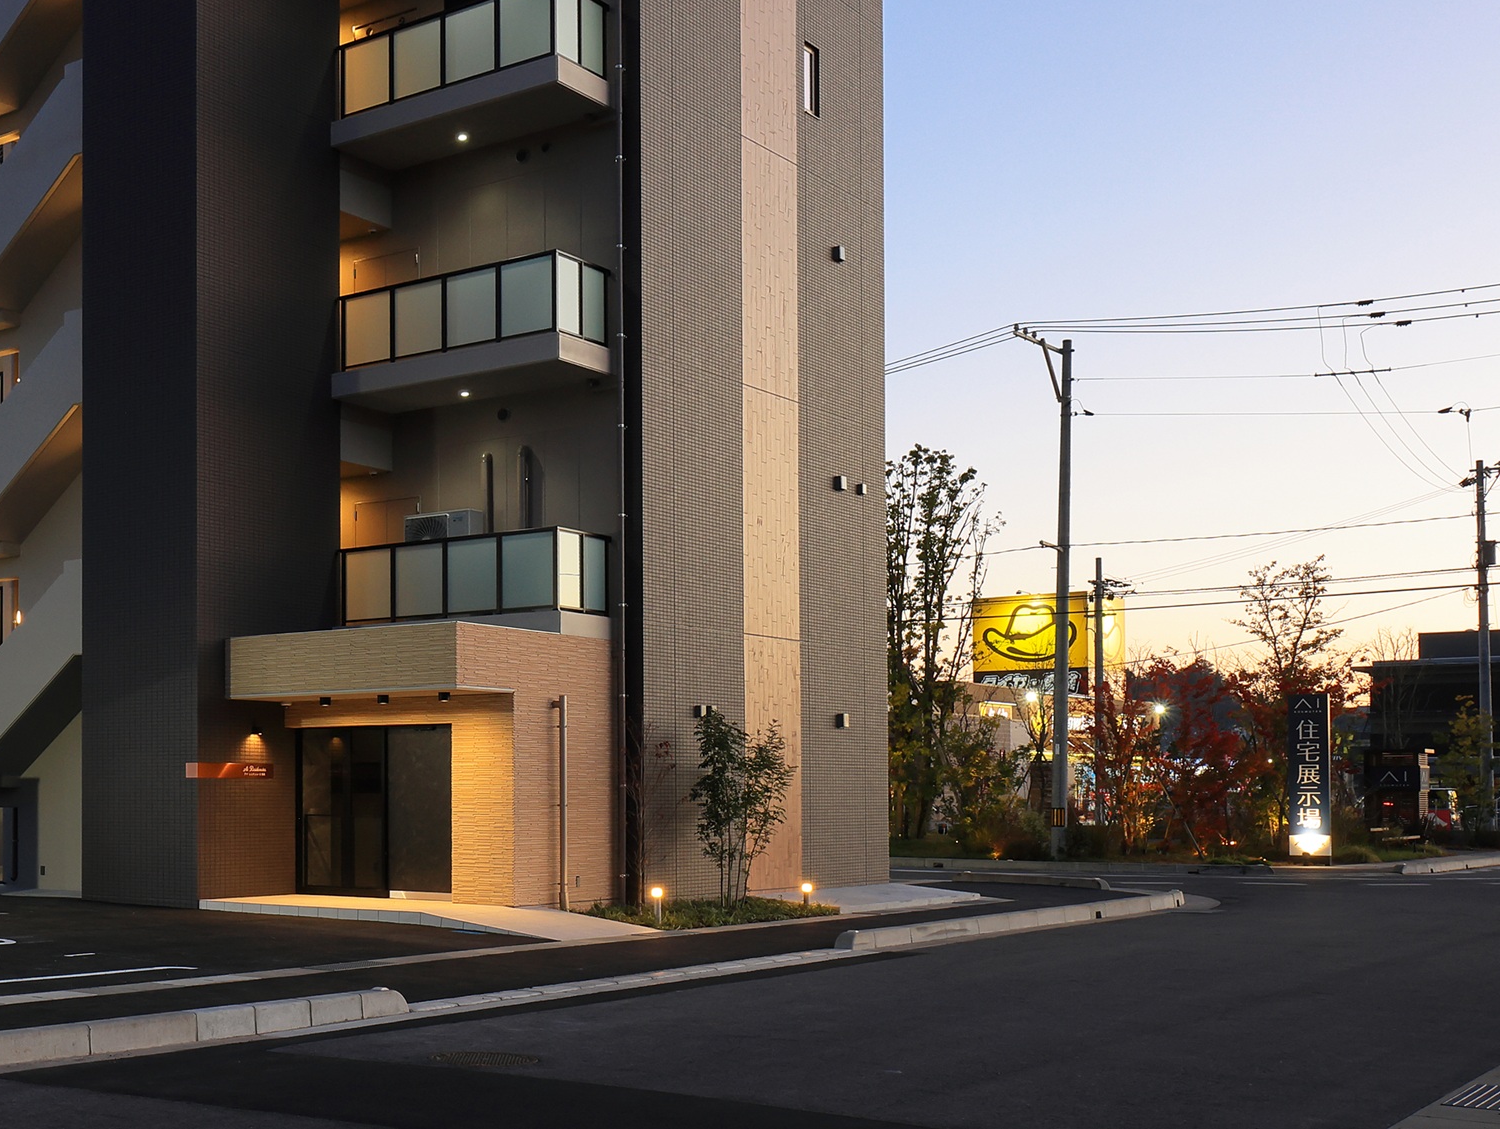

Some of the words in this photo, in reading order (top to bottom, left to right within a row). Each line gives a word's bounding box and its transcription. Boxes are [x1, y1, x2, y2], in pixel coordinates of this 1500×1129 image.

[1294, 698, 1320, 709] AI
[1296, 719, 1322, 829] 住宅展示場
